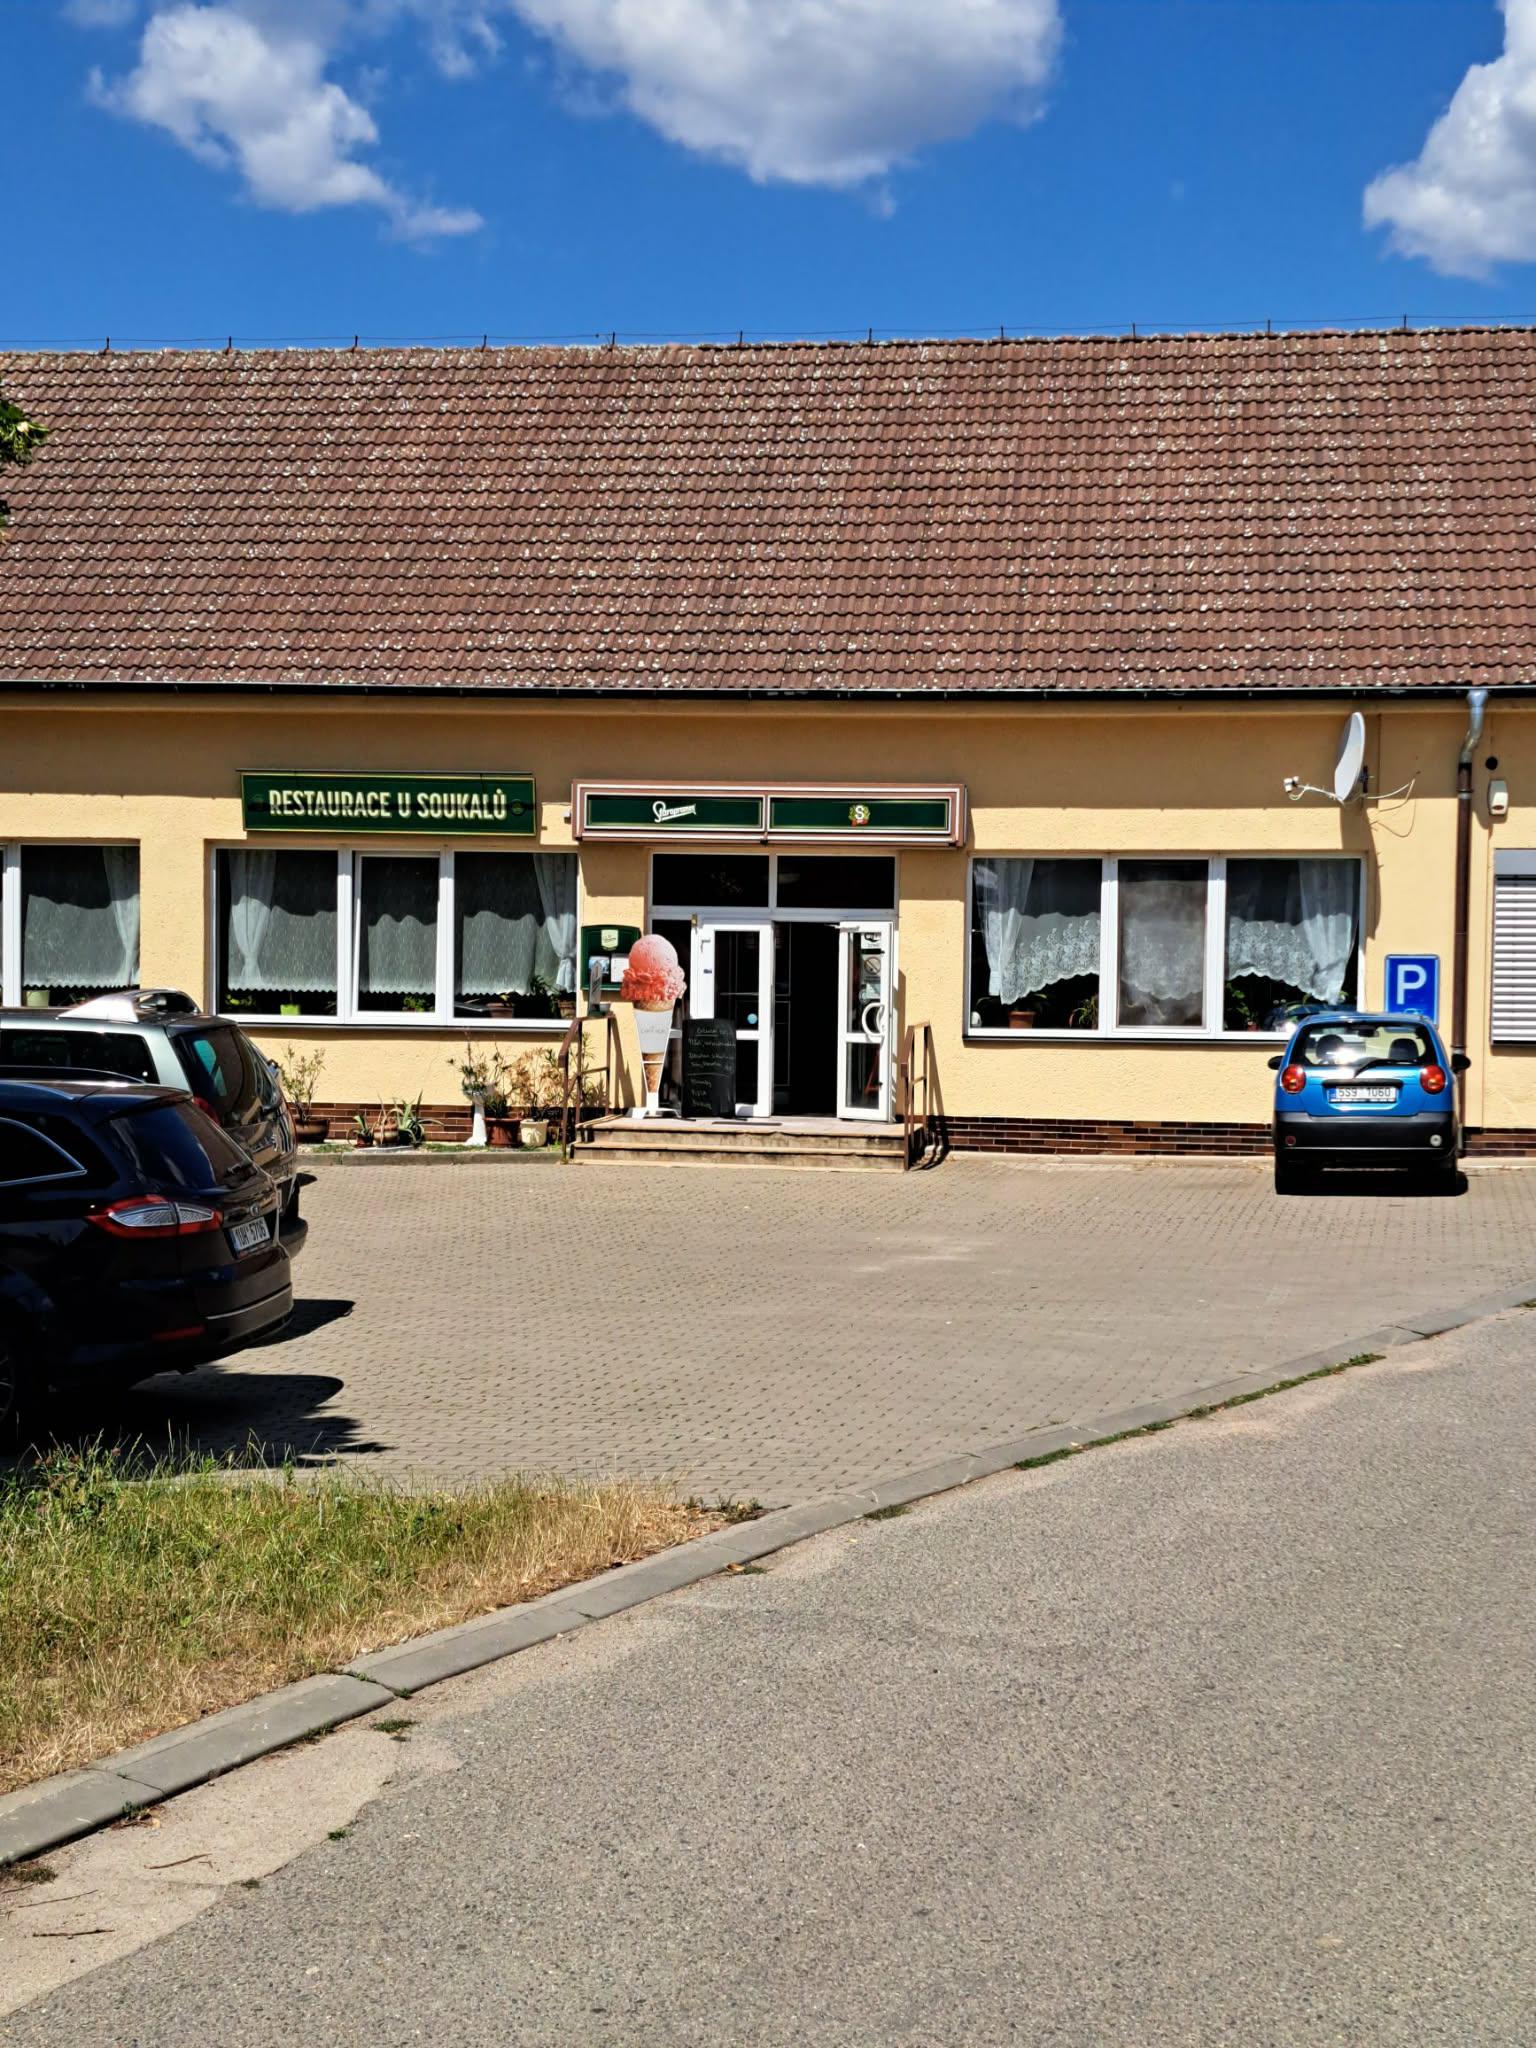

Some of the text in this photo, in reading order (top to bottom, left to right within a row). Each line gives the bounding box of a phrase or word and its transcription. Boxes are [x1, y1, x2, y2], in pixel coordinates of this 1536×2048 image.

[269, 788, 507, 820] RESTAURACE U SOUKALŮ
[1396, 964, 1427, 1005] P
